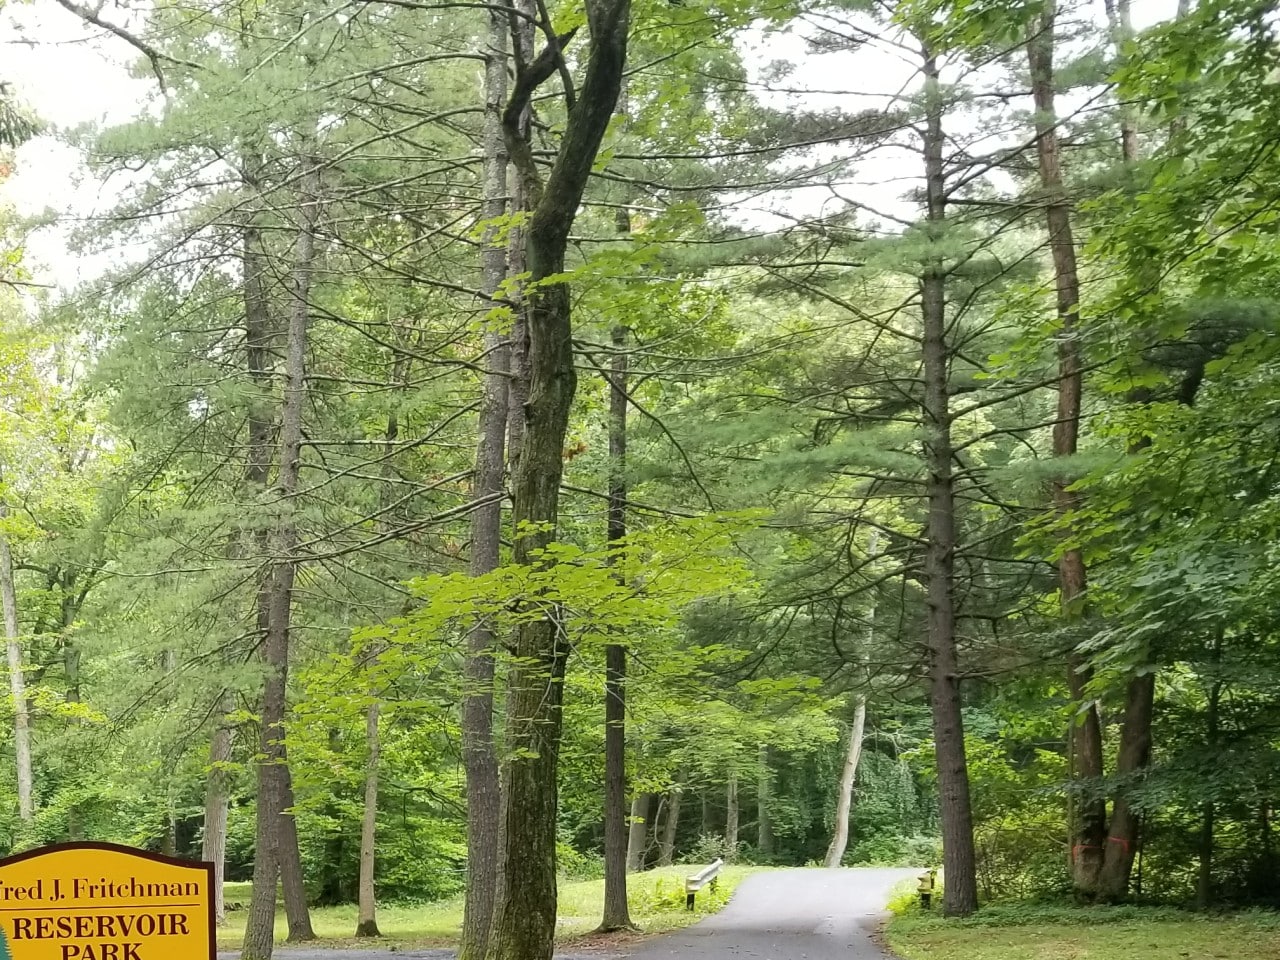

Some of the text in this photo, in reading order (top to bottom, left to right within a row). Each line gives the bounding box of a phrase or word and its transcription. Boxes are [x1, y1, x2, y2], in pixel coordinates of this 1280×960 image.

[50, 878, 65, 901] J.
[72, 877, 199, 899] Fritchman
[12, 913, 190, 940] RESERVOIR
